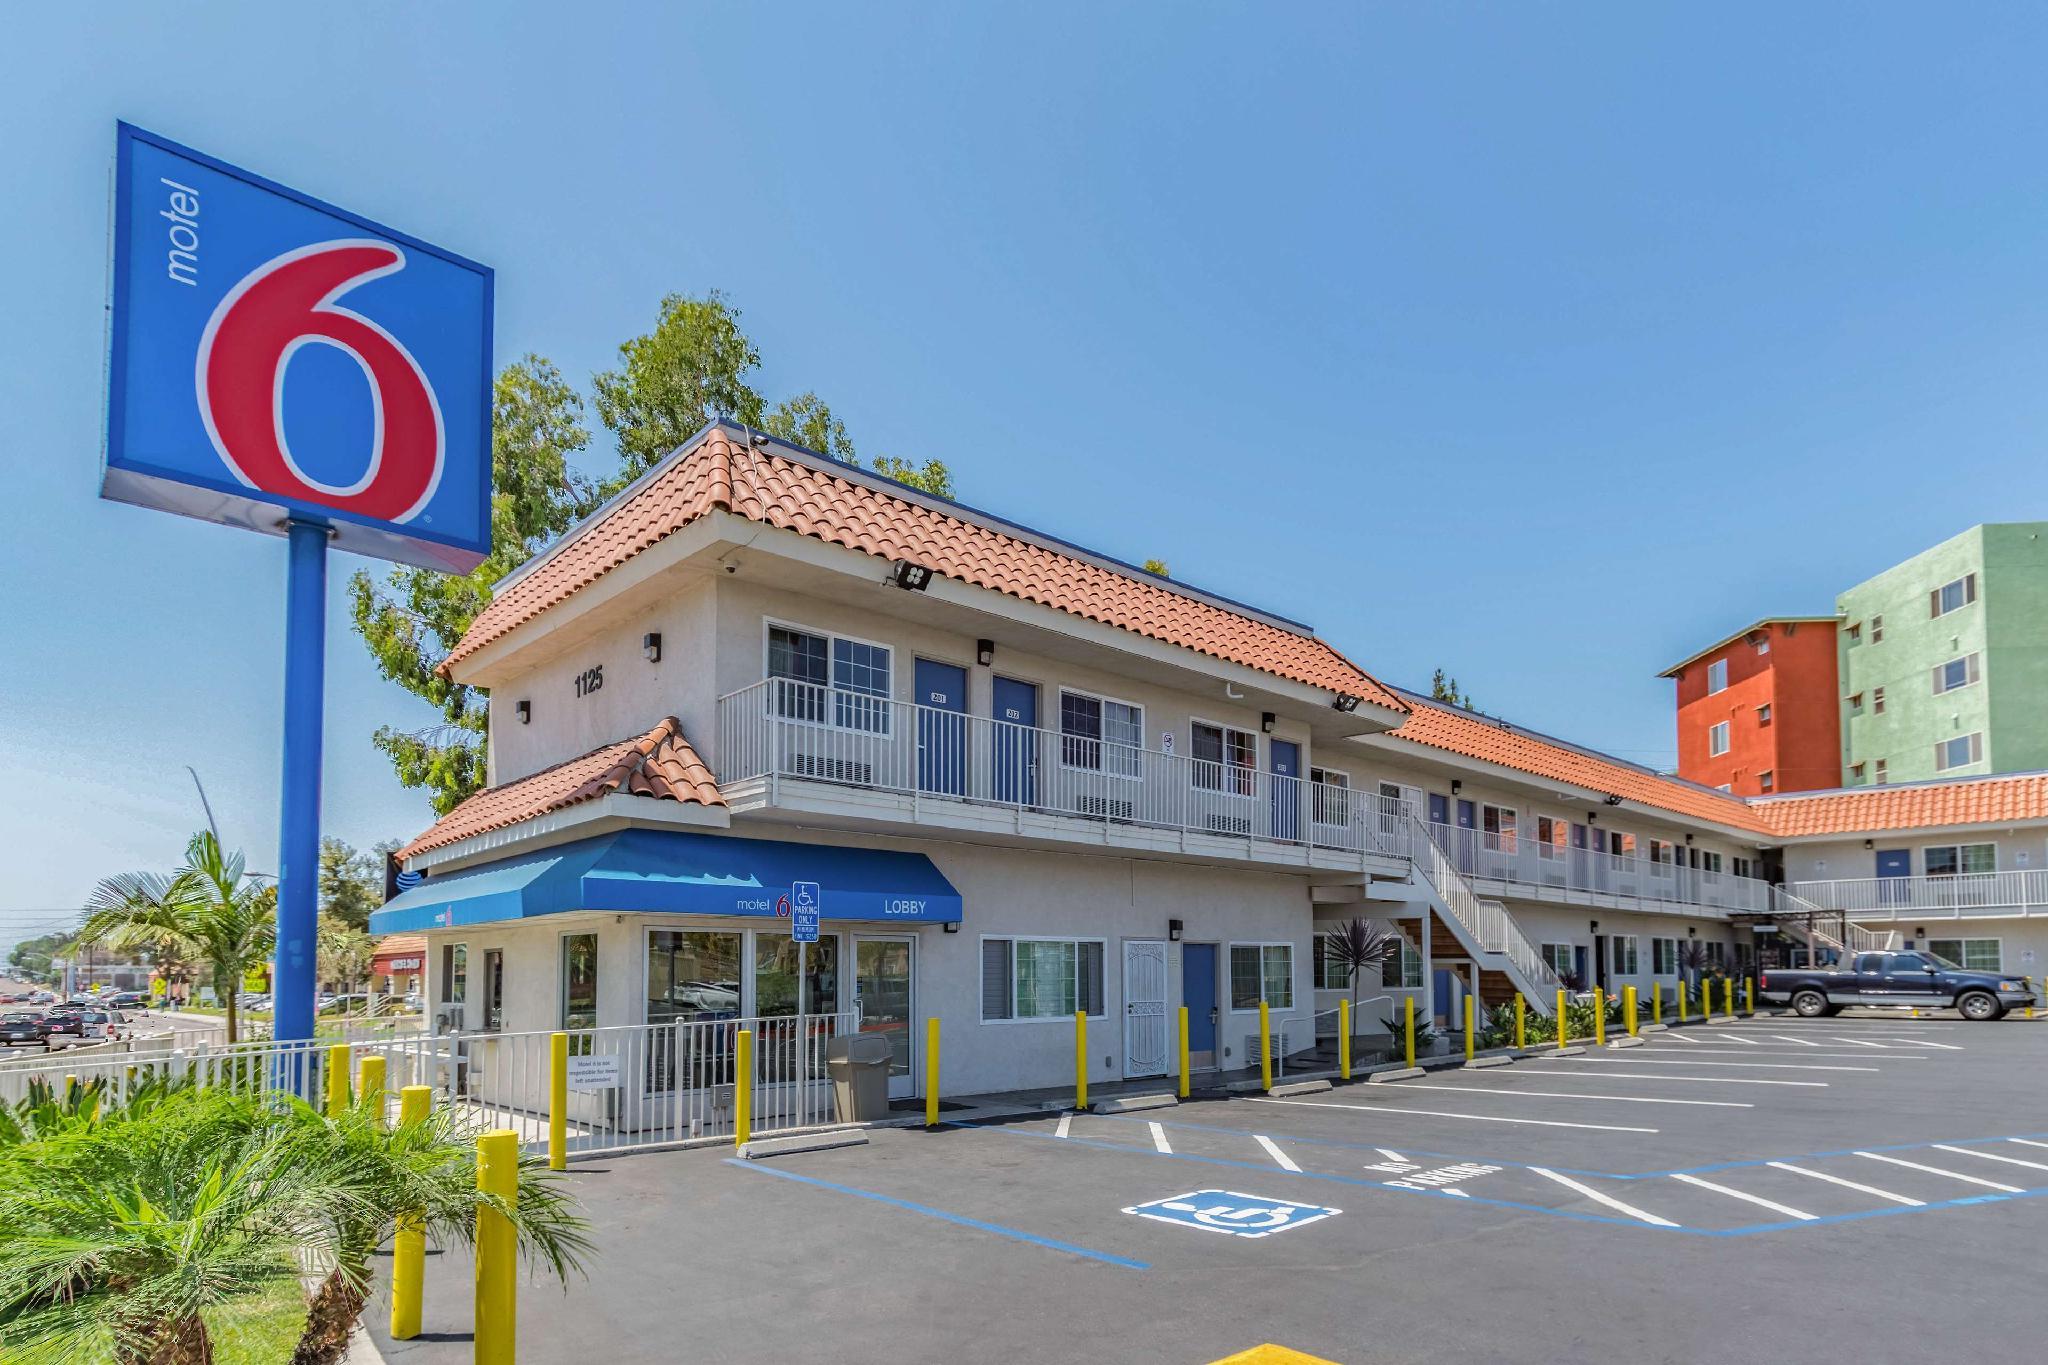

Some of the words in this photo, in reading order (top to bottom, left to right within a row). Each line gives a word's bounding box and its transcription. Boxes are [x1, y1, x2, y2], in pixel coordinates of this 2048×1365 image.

[160, 177, 199, 286] motel
[195, 237, 446, 525] 6
[574, 664, 603, 698] 1125
[932, 693, 946, 703] 201
[737, 899, 770, 910] motel
[776, 893, 792, 918] 6
[795, 905, 818, 915] PARKING
[885, 900, 926, 914] LOBBY
[798, 915, 813, 924] ONLY
[1363, 1162, 1422, 1174] NO
[1382, 1163, 1503, 1191] PARKING
